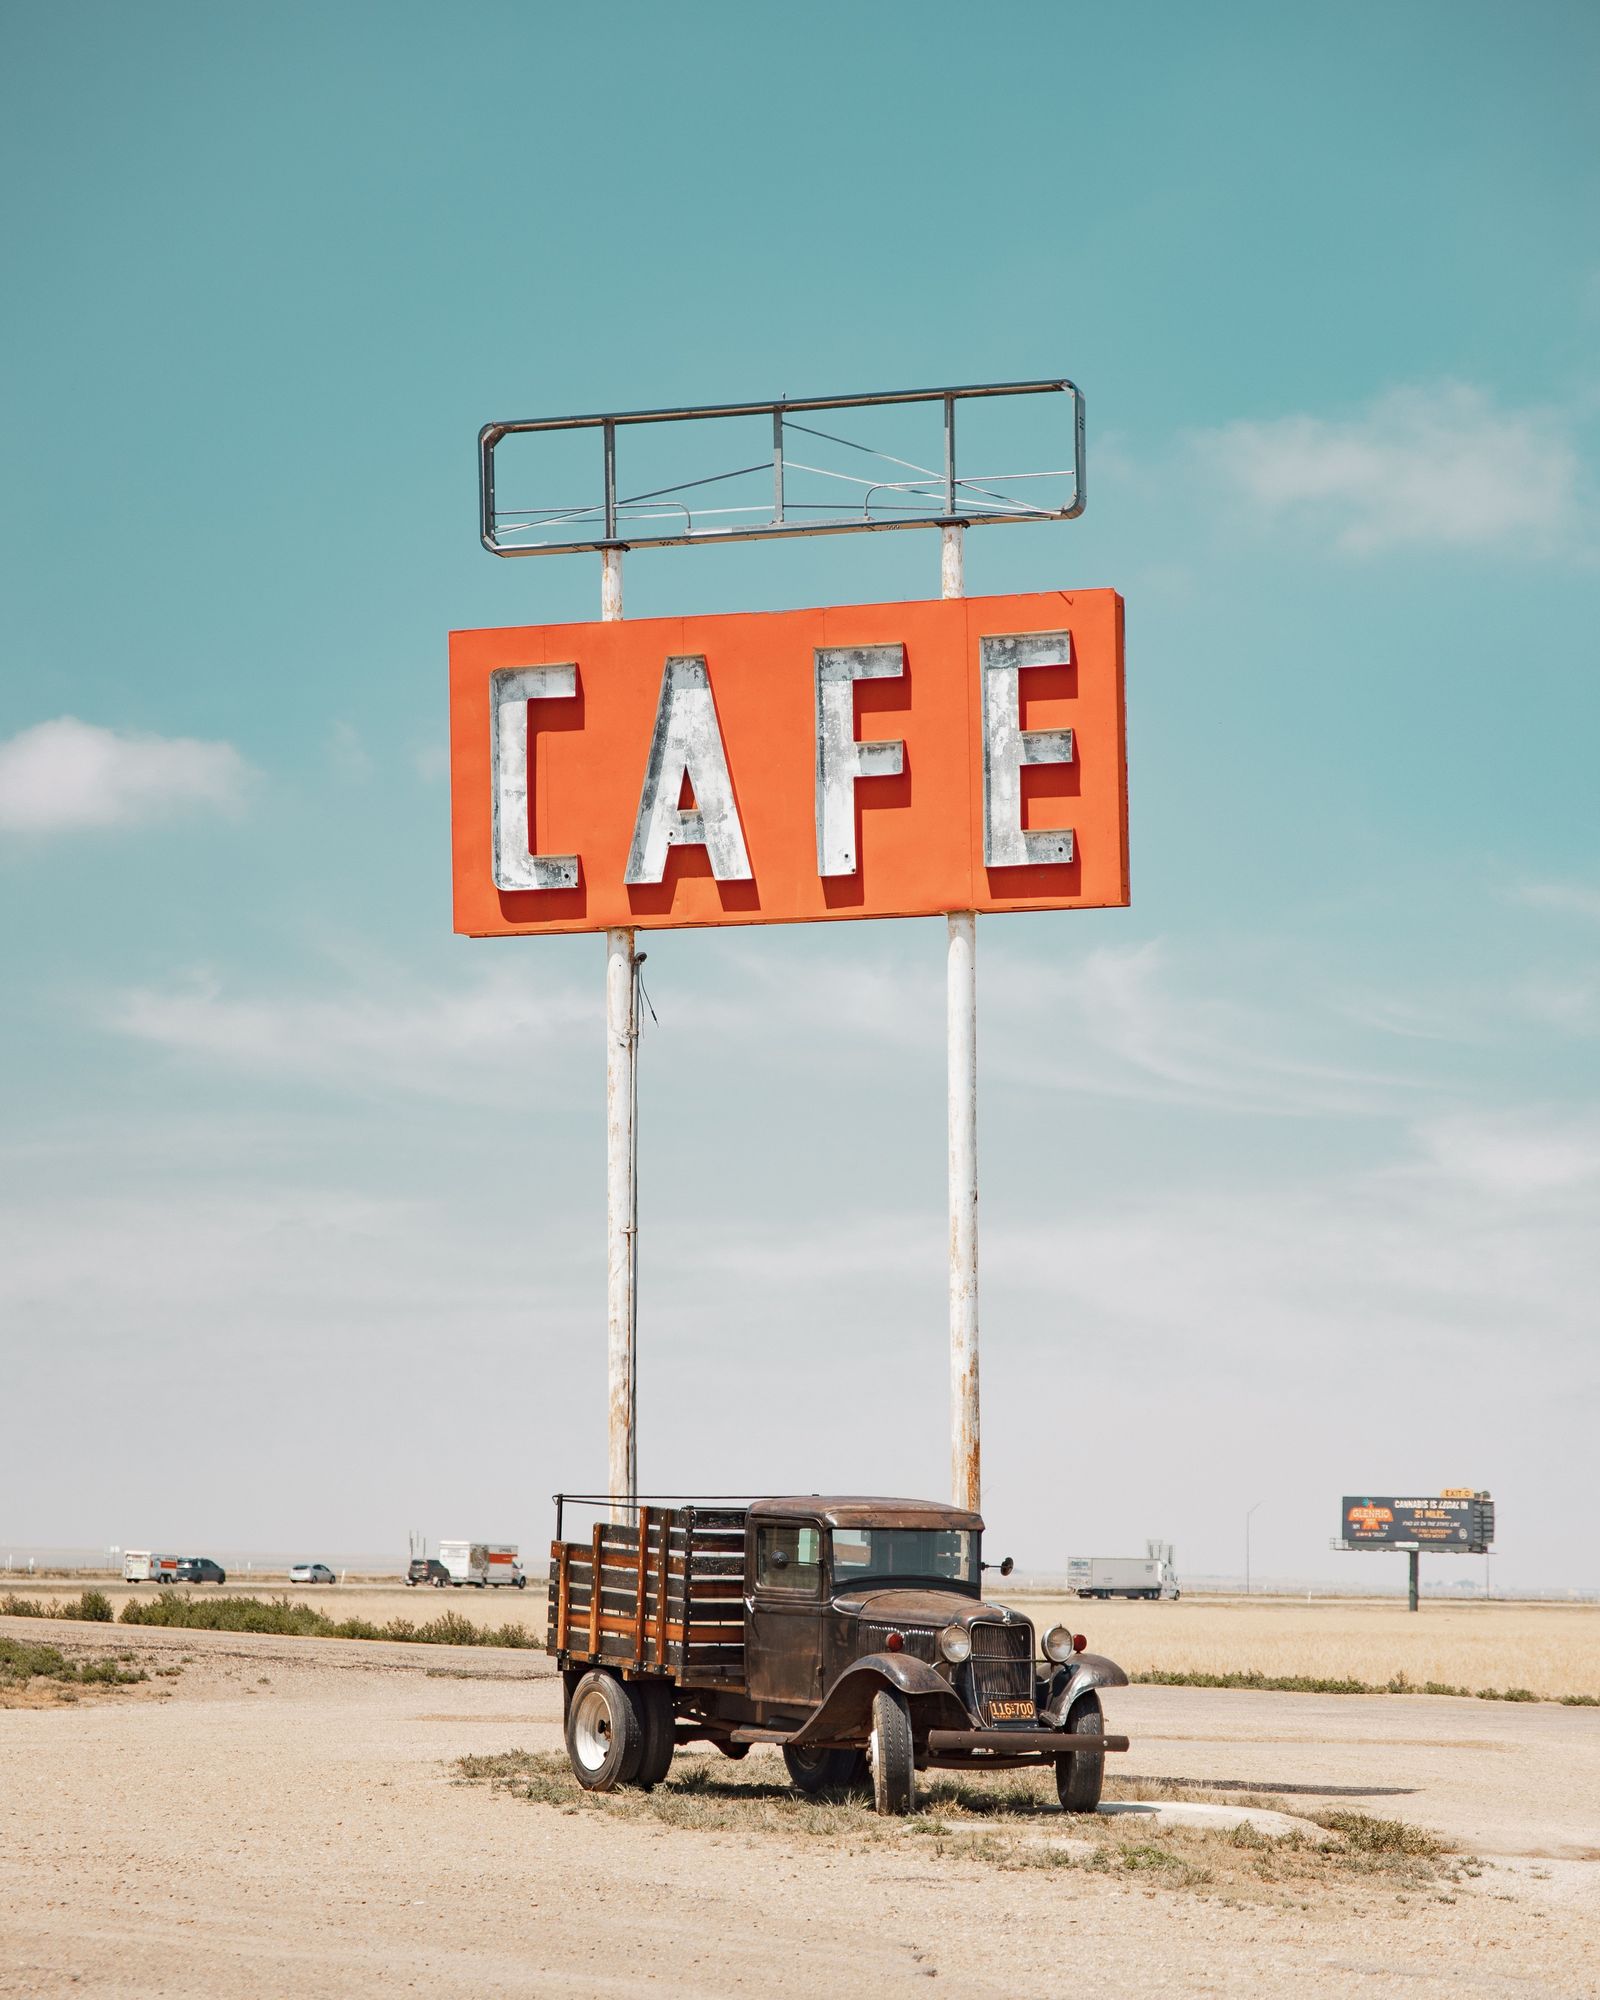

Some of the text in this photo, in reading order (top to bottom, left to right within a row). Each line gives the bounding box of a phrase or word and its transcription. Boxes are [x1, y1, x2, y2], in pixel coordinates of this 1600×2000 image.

[490, 629, 1073, 891] CAFE
[1394, 1500, 1429, 1509] CANNABIS
[1430, 1501, 1437, 1509] IS
[1353, 1509, 1390, 1518] GLENRIO
